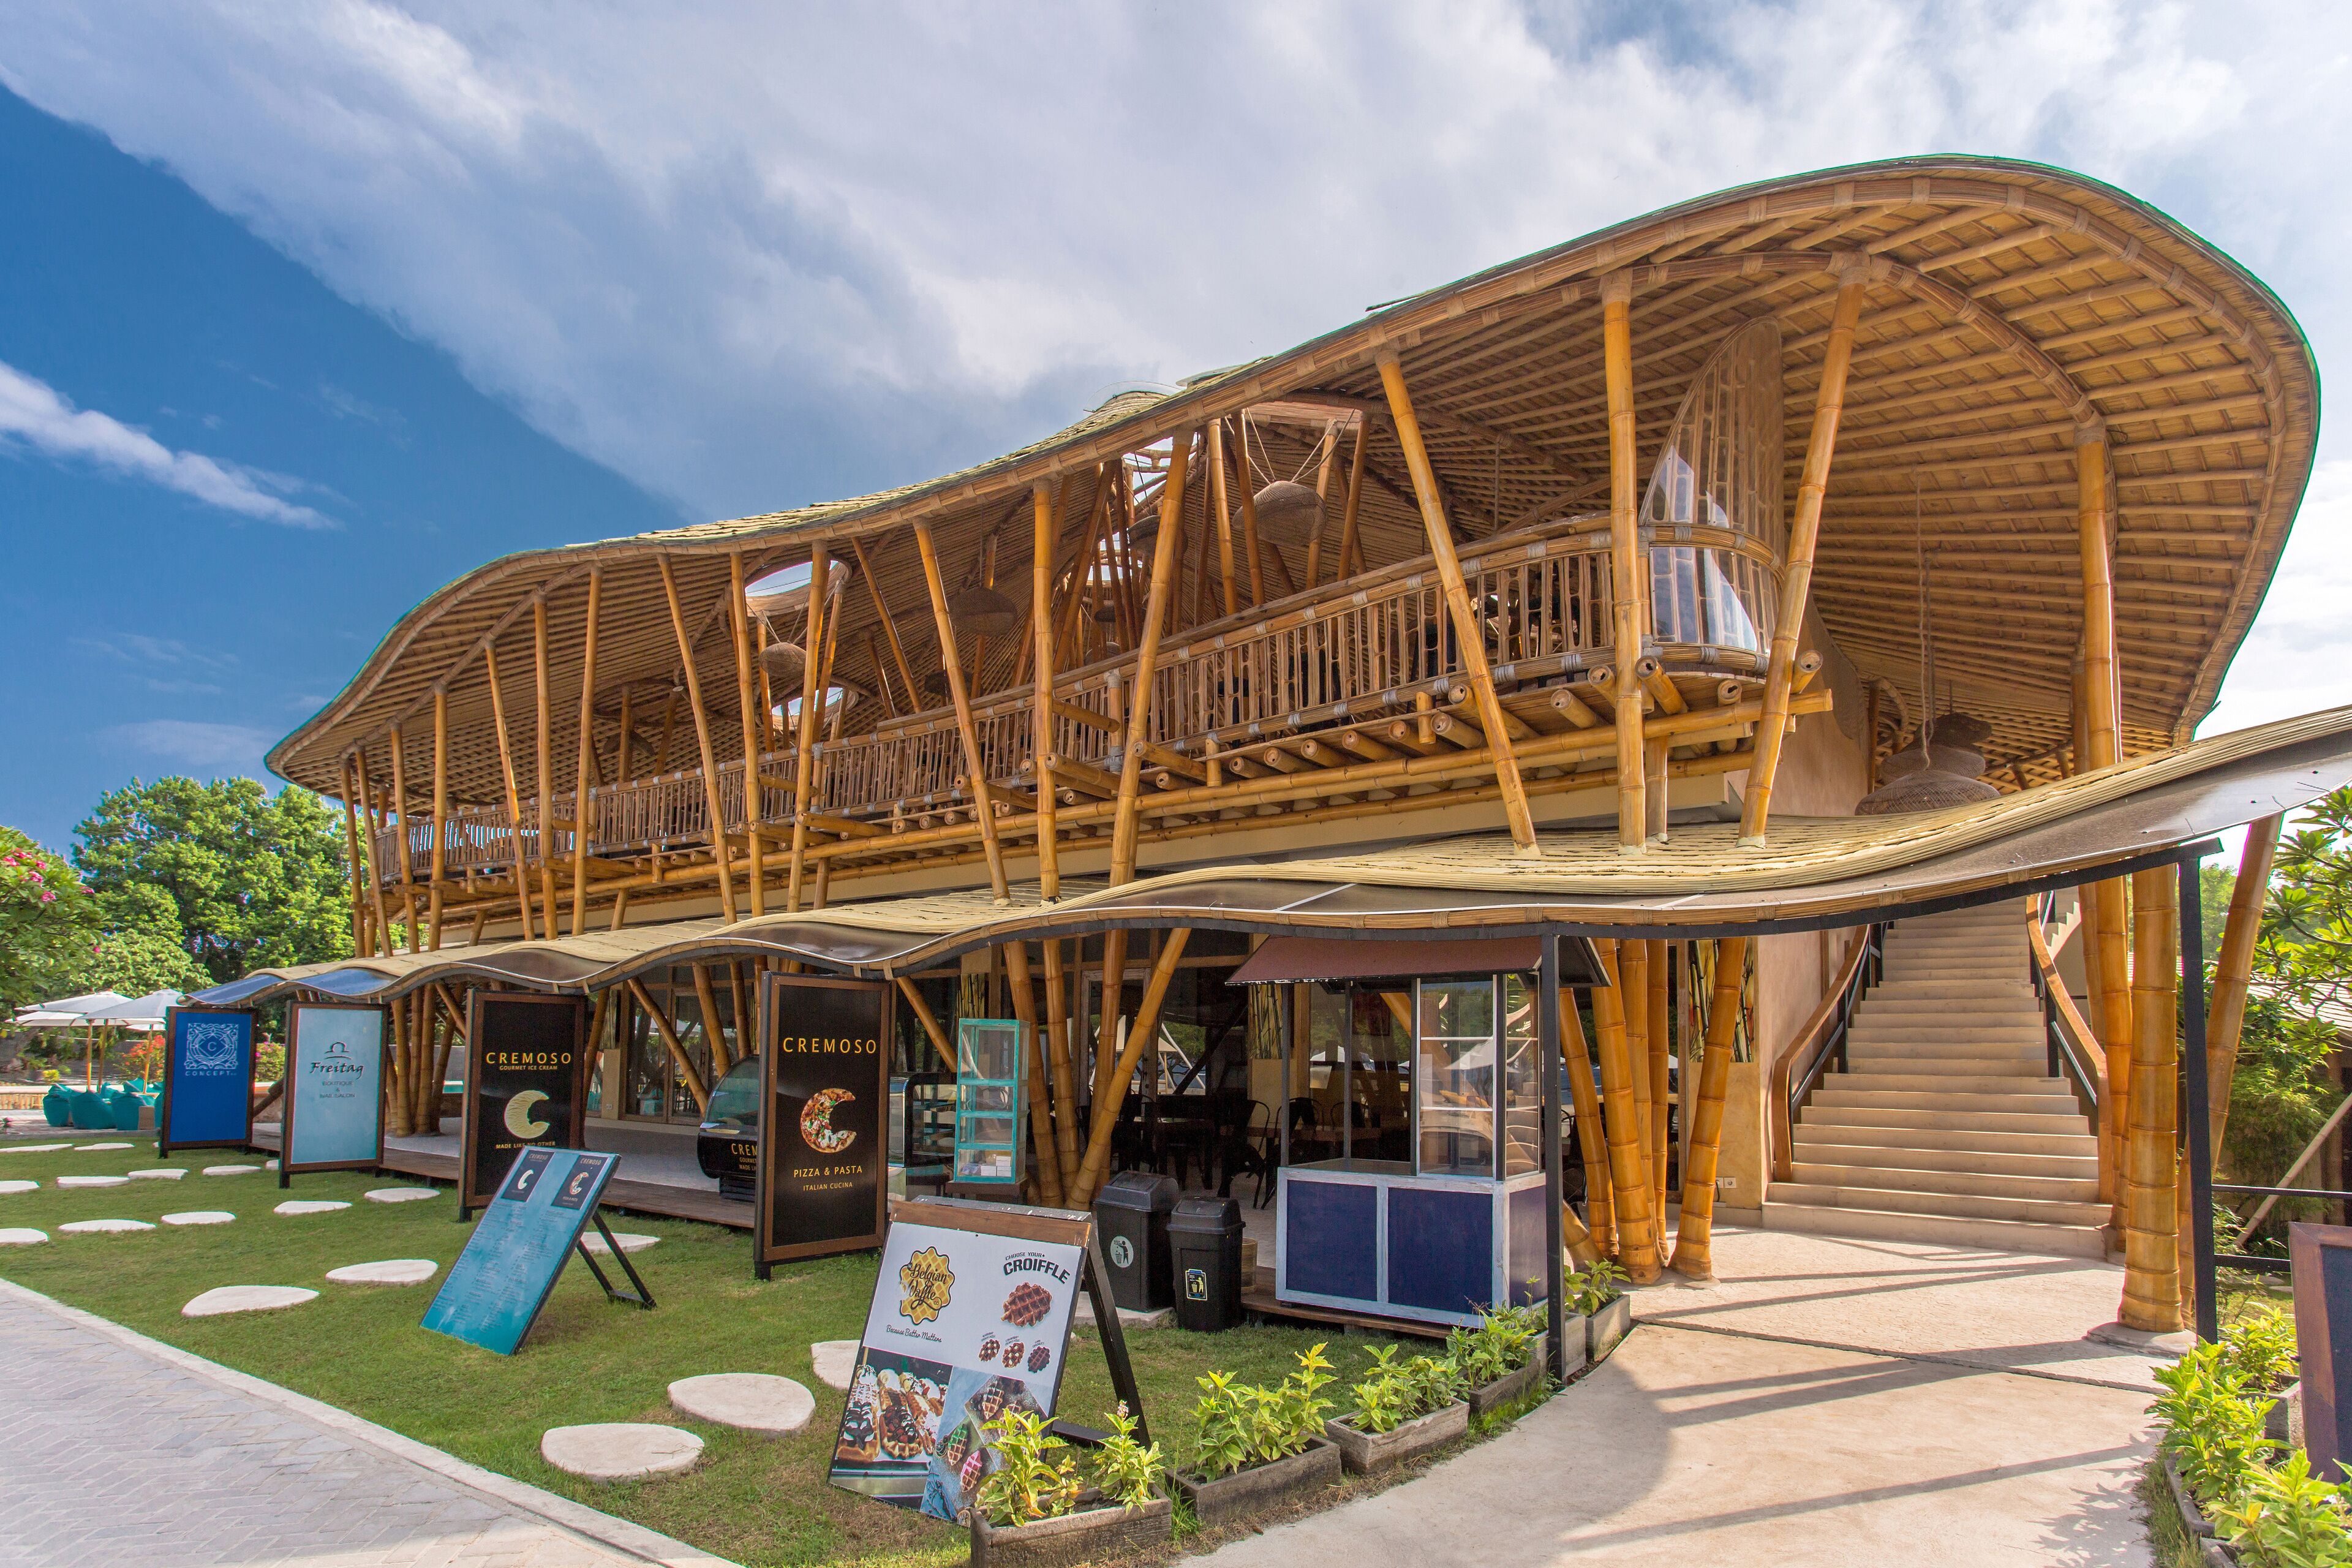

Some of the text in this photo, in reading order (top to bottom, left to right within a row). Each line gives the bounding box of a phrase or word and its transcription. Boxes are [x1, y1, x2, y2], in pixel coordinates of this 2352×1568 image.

[207, 1041, 217, 1051] C
[783, 1037, 876, 1054] CREMOSO
[486, 1052, 571, 1064] CREMOSO
[309, 1061, 364, 1080] Freitag
[731, 1143, 758, 1156] CREM
[793, 1165, 862, 1178] PIZZA & PASTA
[1005, 1251, 1026, 1261] CHOOSE
[907, 1262, 948, 1285] Belgian
[1003, 1257, 1071, 1284] CROIFFLE
[886, 1324, 905, 1335] Because
[921, 1331, 942, 1343] Matters
